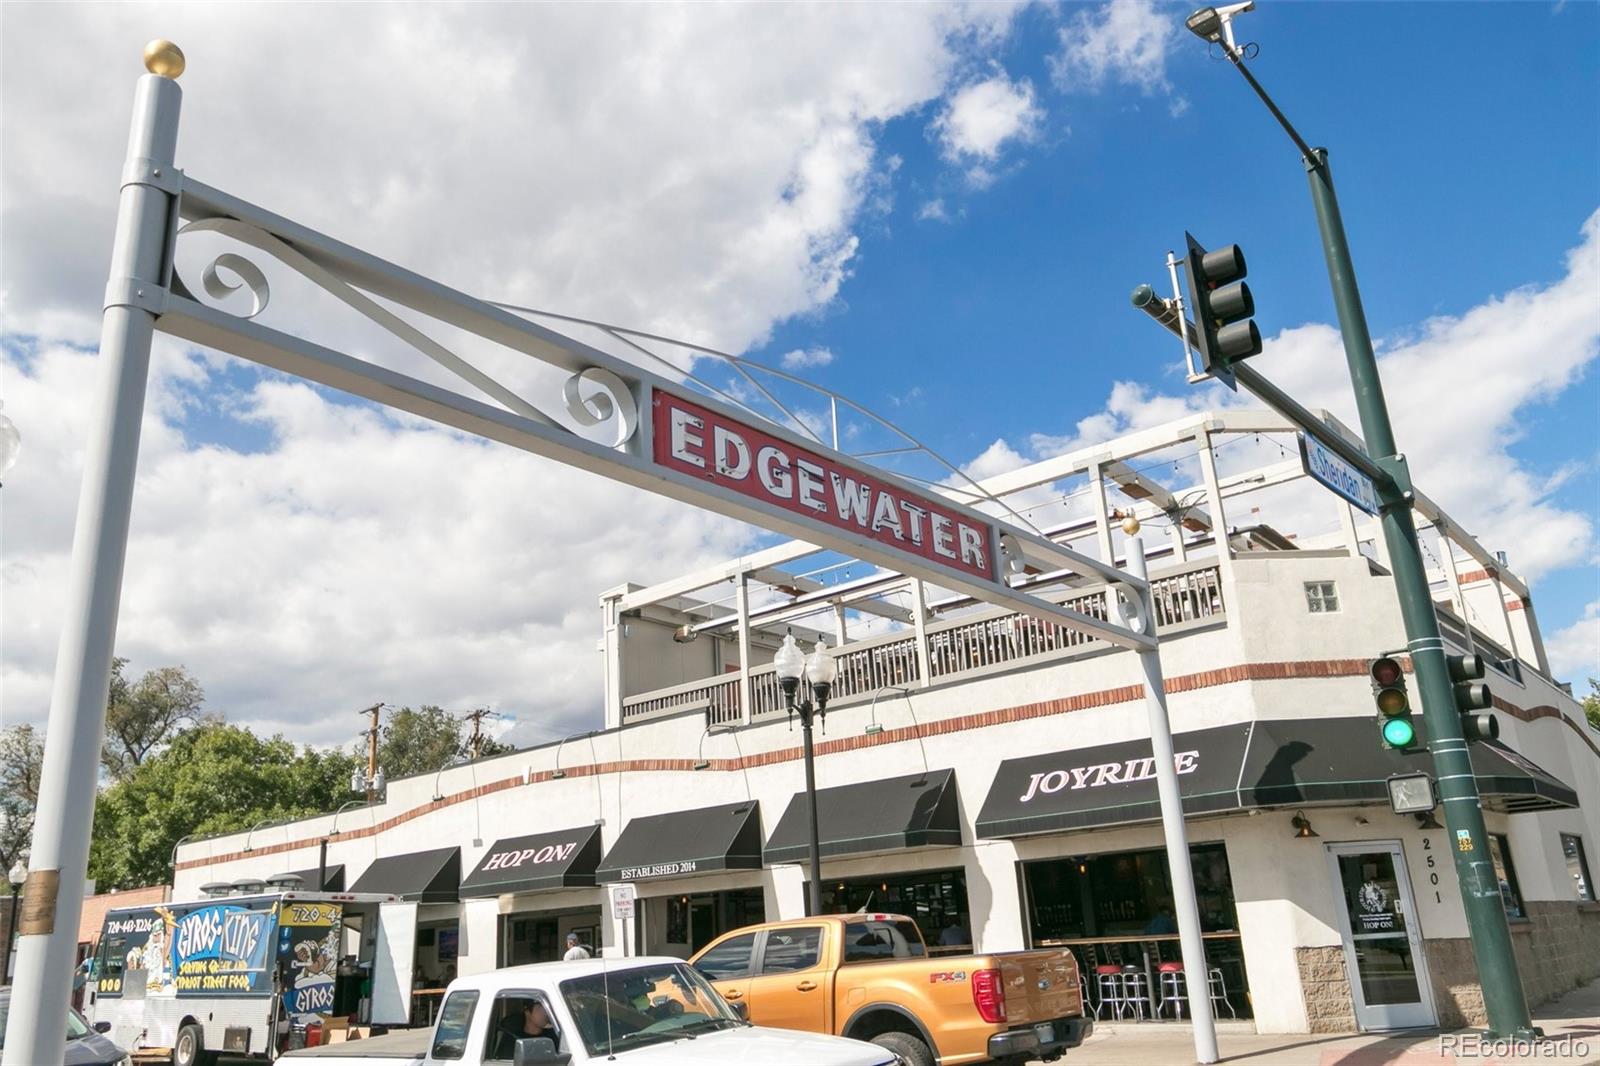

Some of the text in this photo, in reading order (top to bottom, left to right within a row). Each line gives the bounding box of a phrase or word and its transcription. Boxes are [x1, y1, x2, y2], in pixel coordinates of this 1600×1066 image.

[670, 406, 986, 570] EDGEWATER
[1316, 447, 1362, 502] Sheridan
[1019, 750, 1199, 802] JOYRIDE
[481, 842, 578, 871] HOP ON!
[621, 861, 697, 879] ESTABLISHED 2014
[1423, 838, 1441, 904] 2501
[225, 909, 259, 960] KING
[203, 975, 228, 989] STREET
[929, 970, 967, 984] FX4
[295, 985, 335, 1012] GYROS
